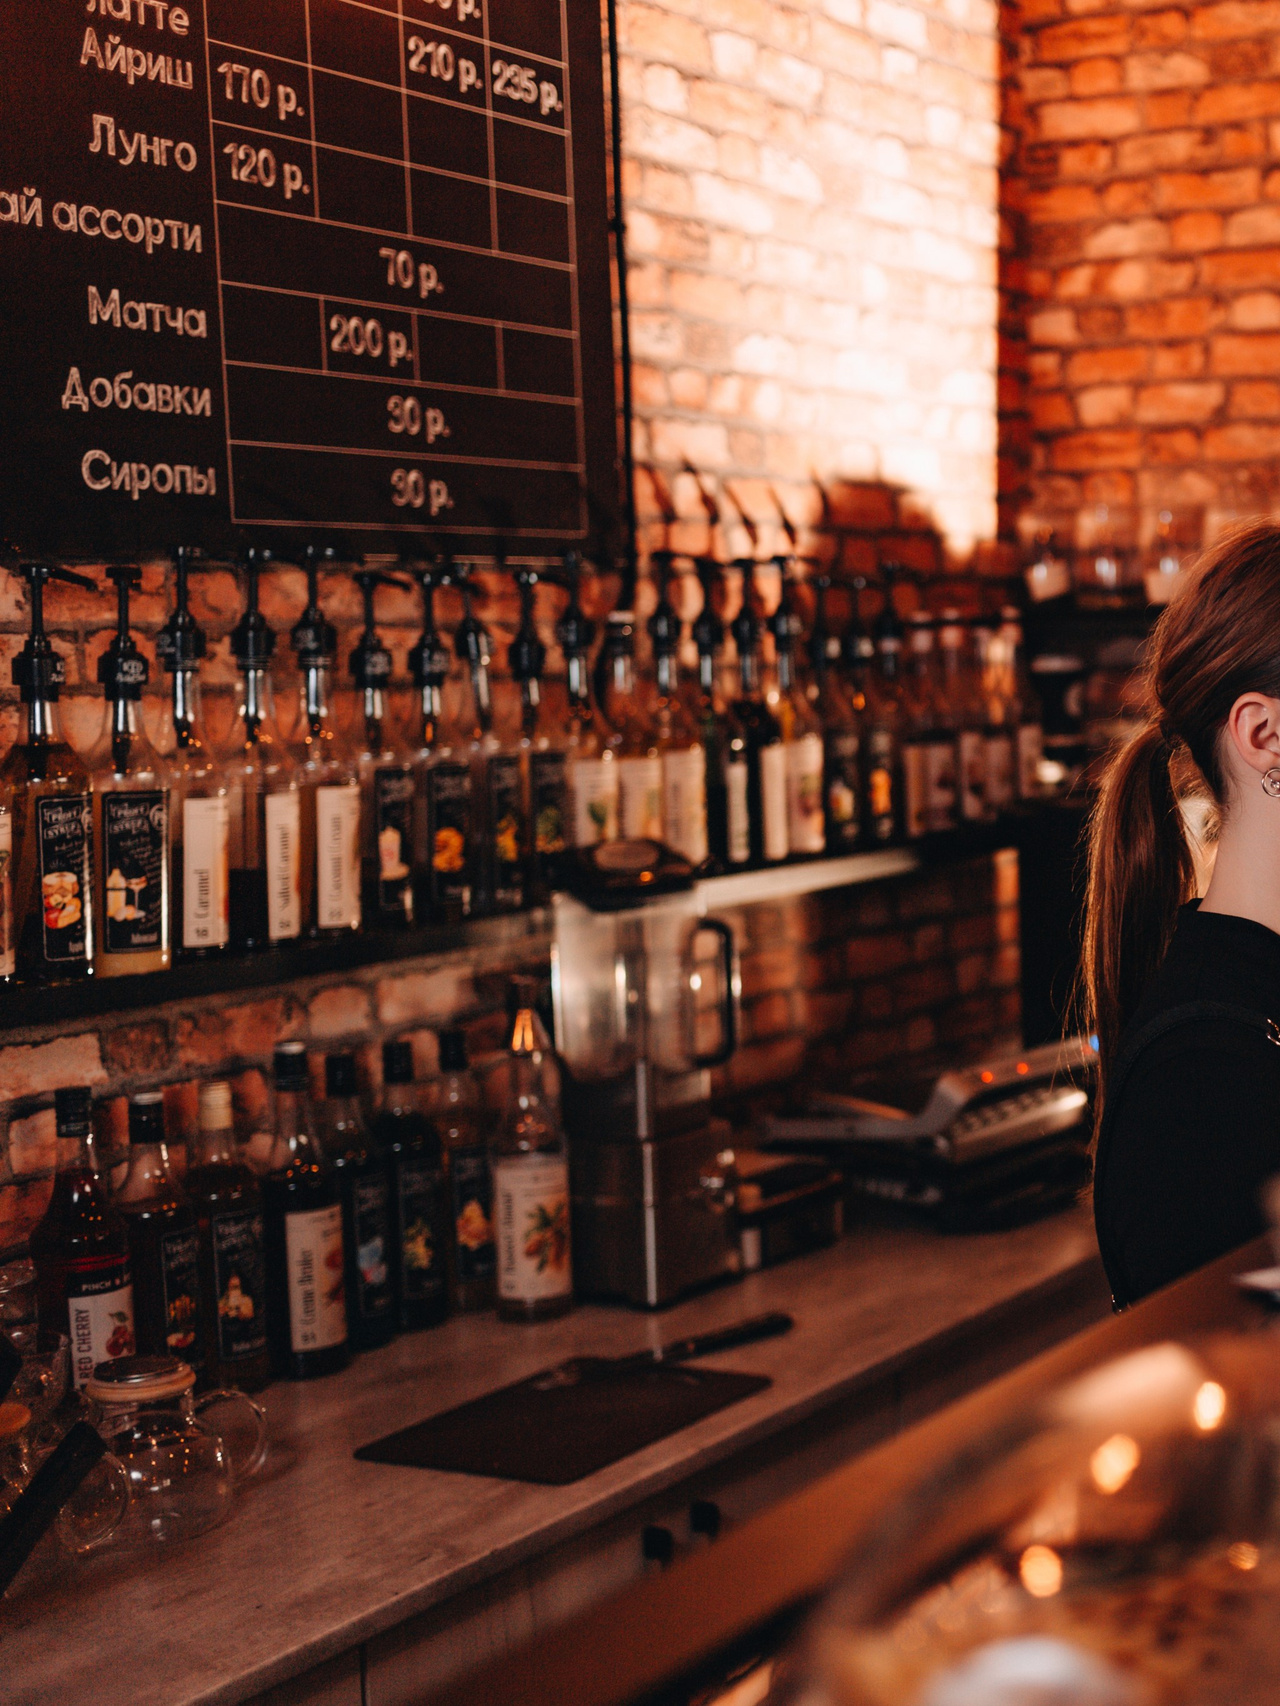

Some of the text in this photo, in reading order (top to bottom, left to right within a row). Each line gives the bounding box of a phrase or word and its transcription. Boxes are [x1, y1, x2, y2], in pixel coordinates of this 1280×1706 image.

[80, 26, 193, 90] Айриш
[408, 35, 483, 93] 210 р.
[217, 62, 305, 121] 170 р.
[492, 59, 563, 116] 235 р.
[89, 113, 197, 172] Лунго
[223, 142, 311, 199] 120 р.
[52, 201, 202, 254] ассорти
[379, 246, 444, 299] 70 р.
[87, 285, 207, 338] Матча
[329, 313, 413, 367] 200 р.
[61, 366, 212, 417] Добавки
[387, 395, 450, 444] 30 р.
[81, 449, 216, 501] Сиропы
[390, 468, 454, 517] 30 р.
[75, 1308, 93, 1379] RED CHERRY
